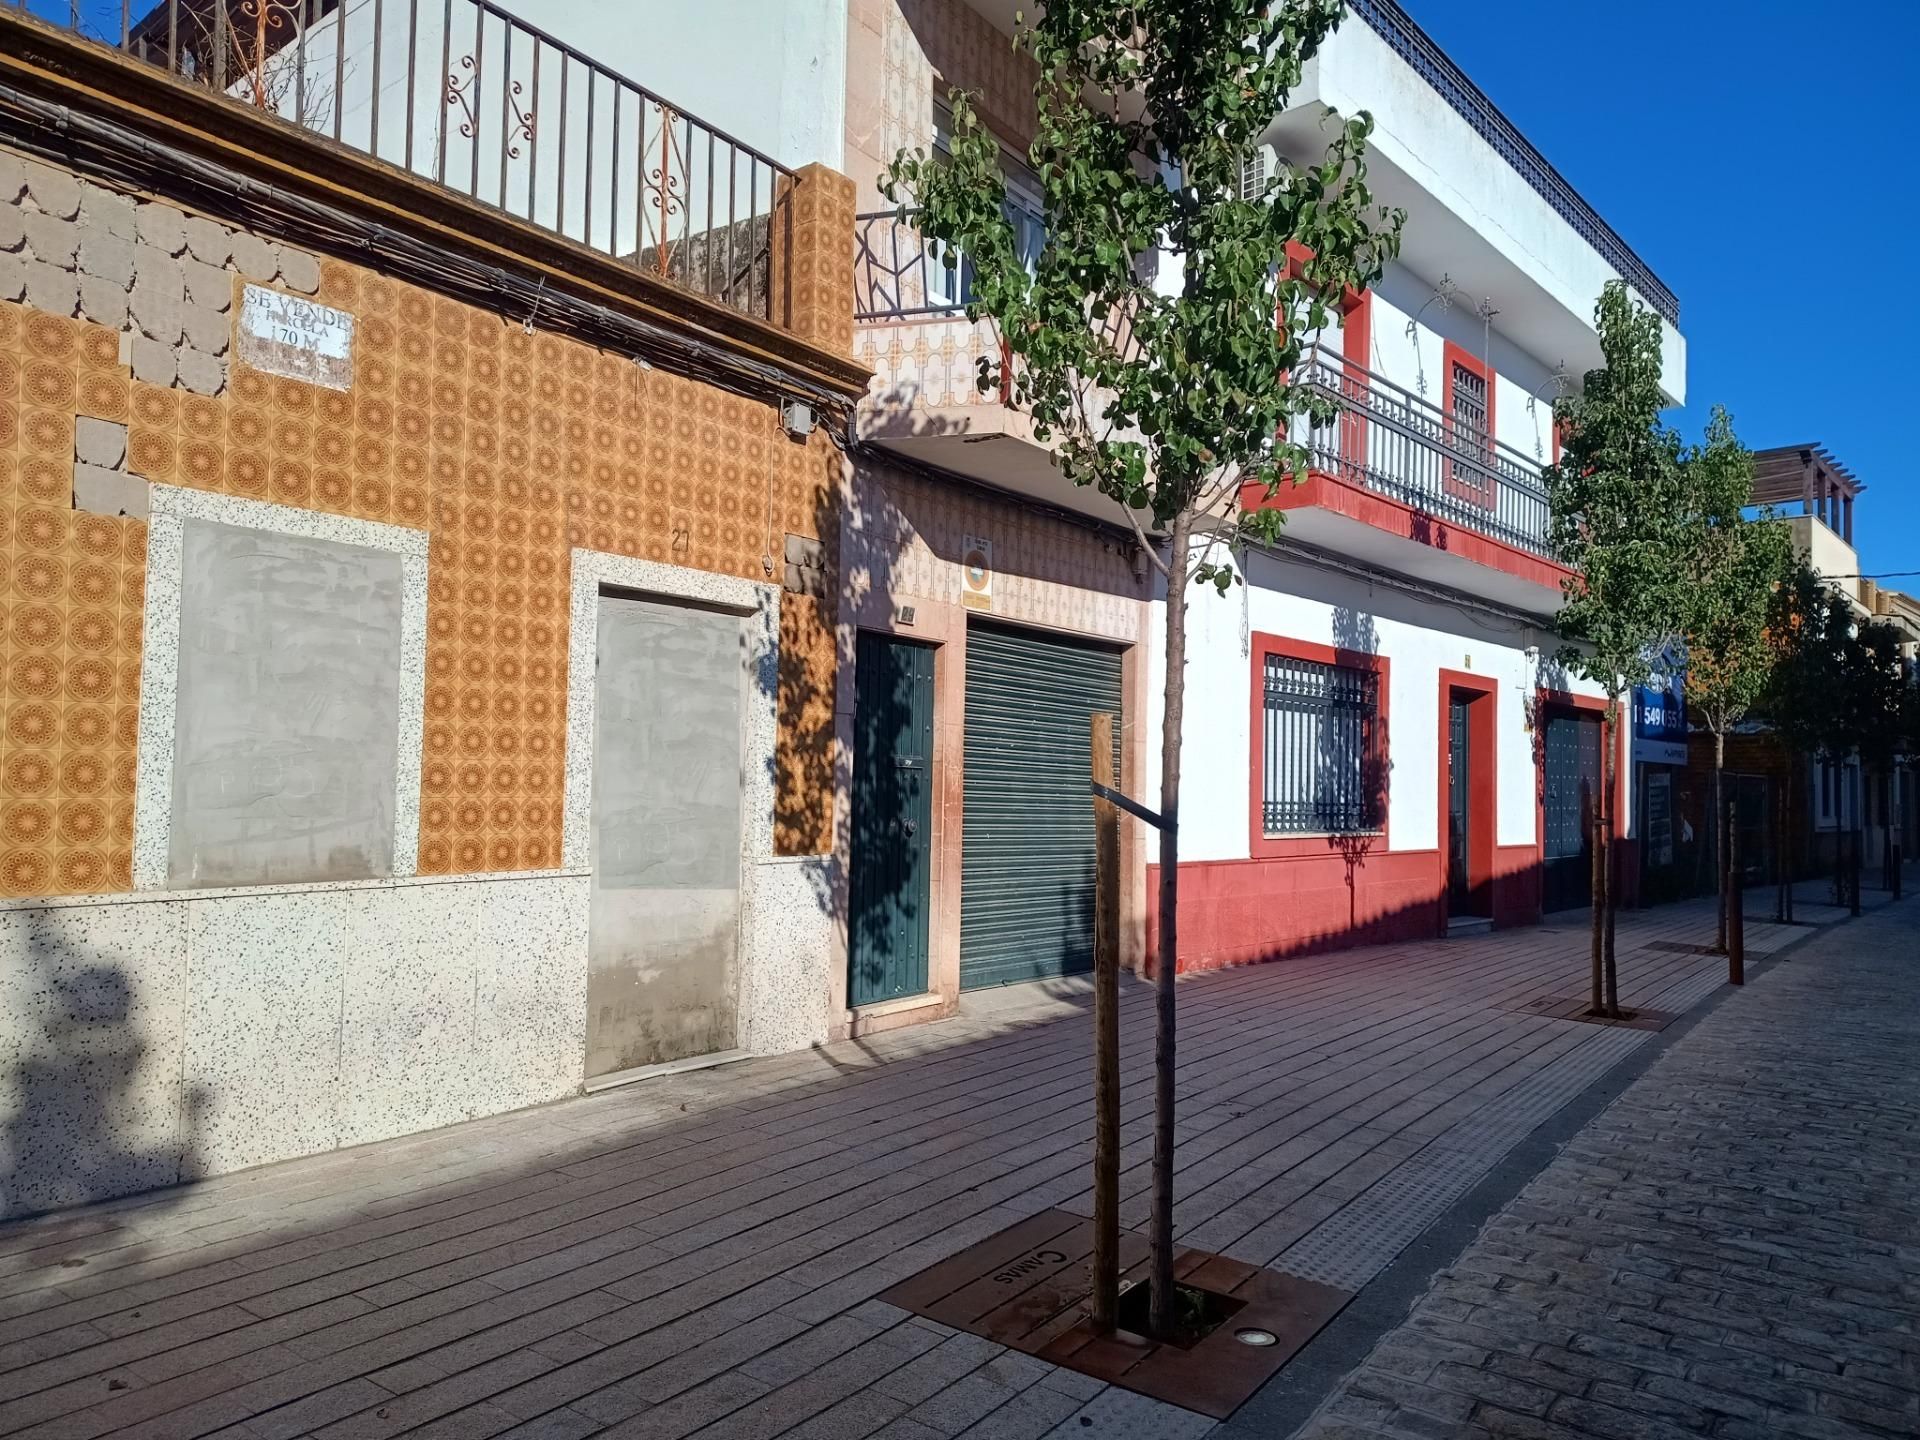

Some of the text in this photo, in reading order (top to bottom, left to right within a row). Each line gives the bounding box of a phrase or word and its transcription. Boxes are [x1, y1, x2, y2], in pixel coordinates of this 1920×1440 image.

[246, 287, 351, 331] SE VENDE
[671, 528, 690, 553] 27
[993, 1249, 1068, 1285] CAMAS
